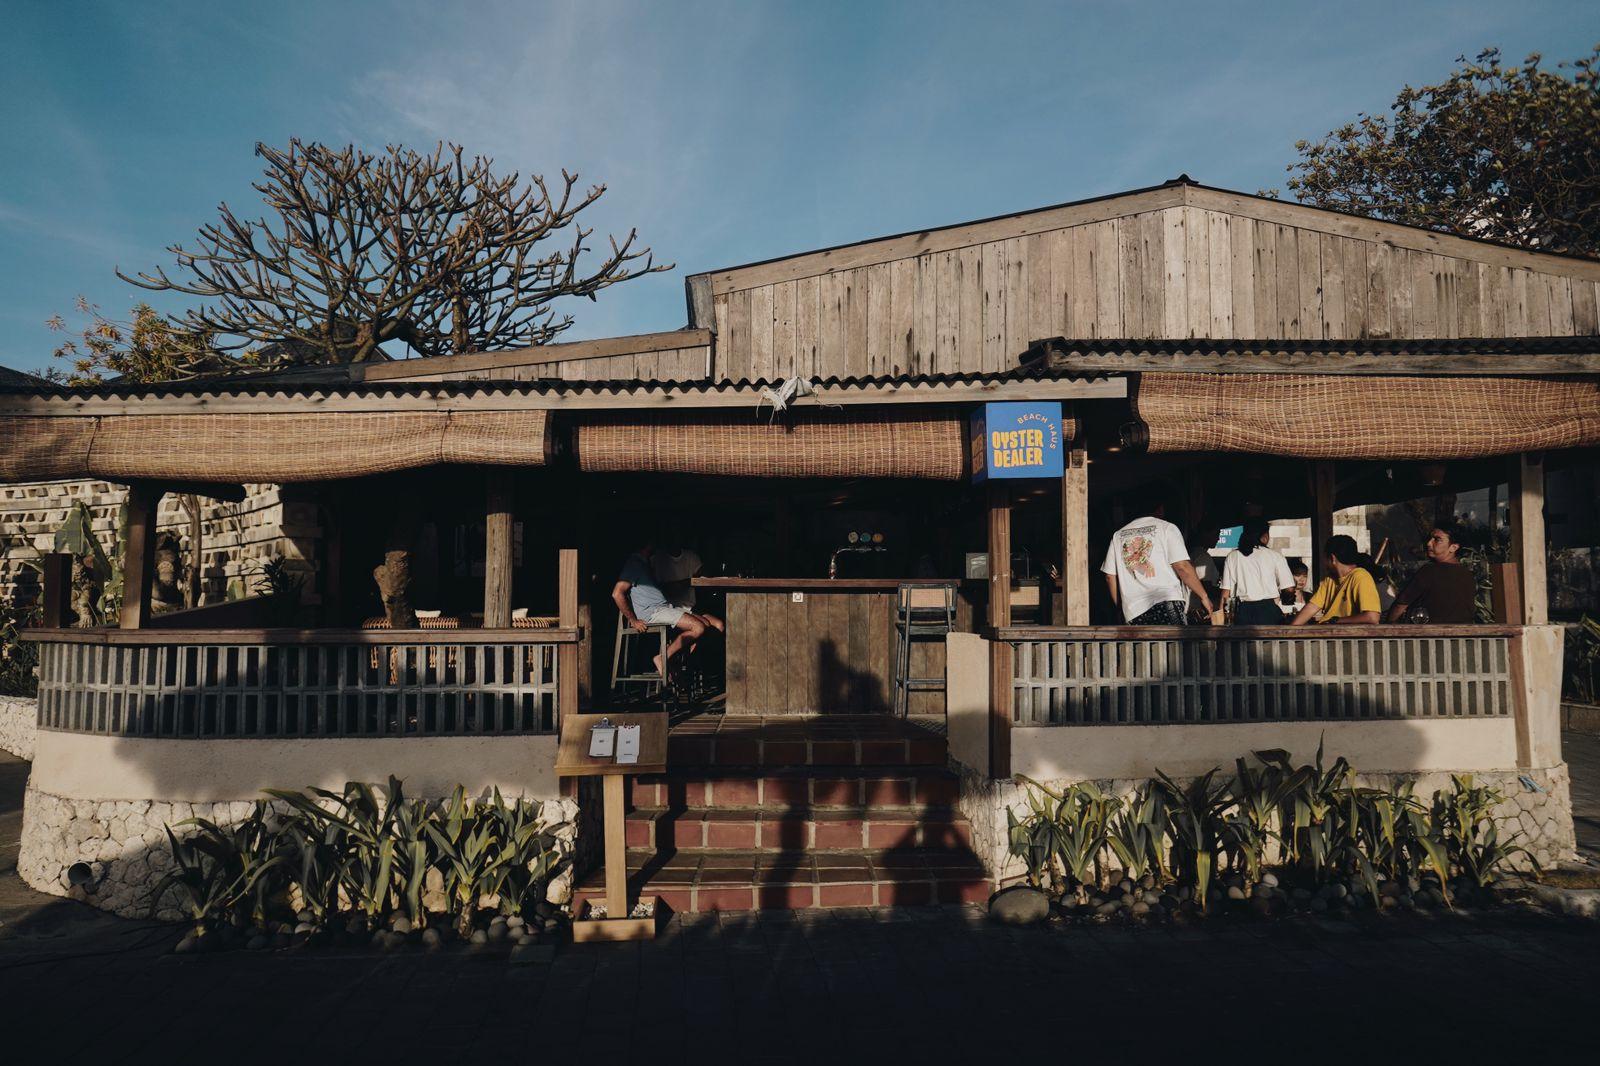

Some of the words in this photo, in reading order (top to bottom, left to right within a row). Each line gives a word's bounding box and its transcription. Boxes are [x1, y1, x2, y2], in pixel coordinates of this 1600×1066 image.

[992, 429, 1043, 449] OYSTER
[1017, 413, 1048, 424] BEACH
[1048, 423, 1058, 449] HAUS
[993, 447, 1043, 467] DEALER
